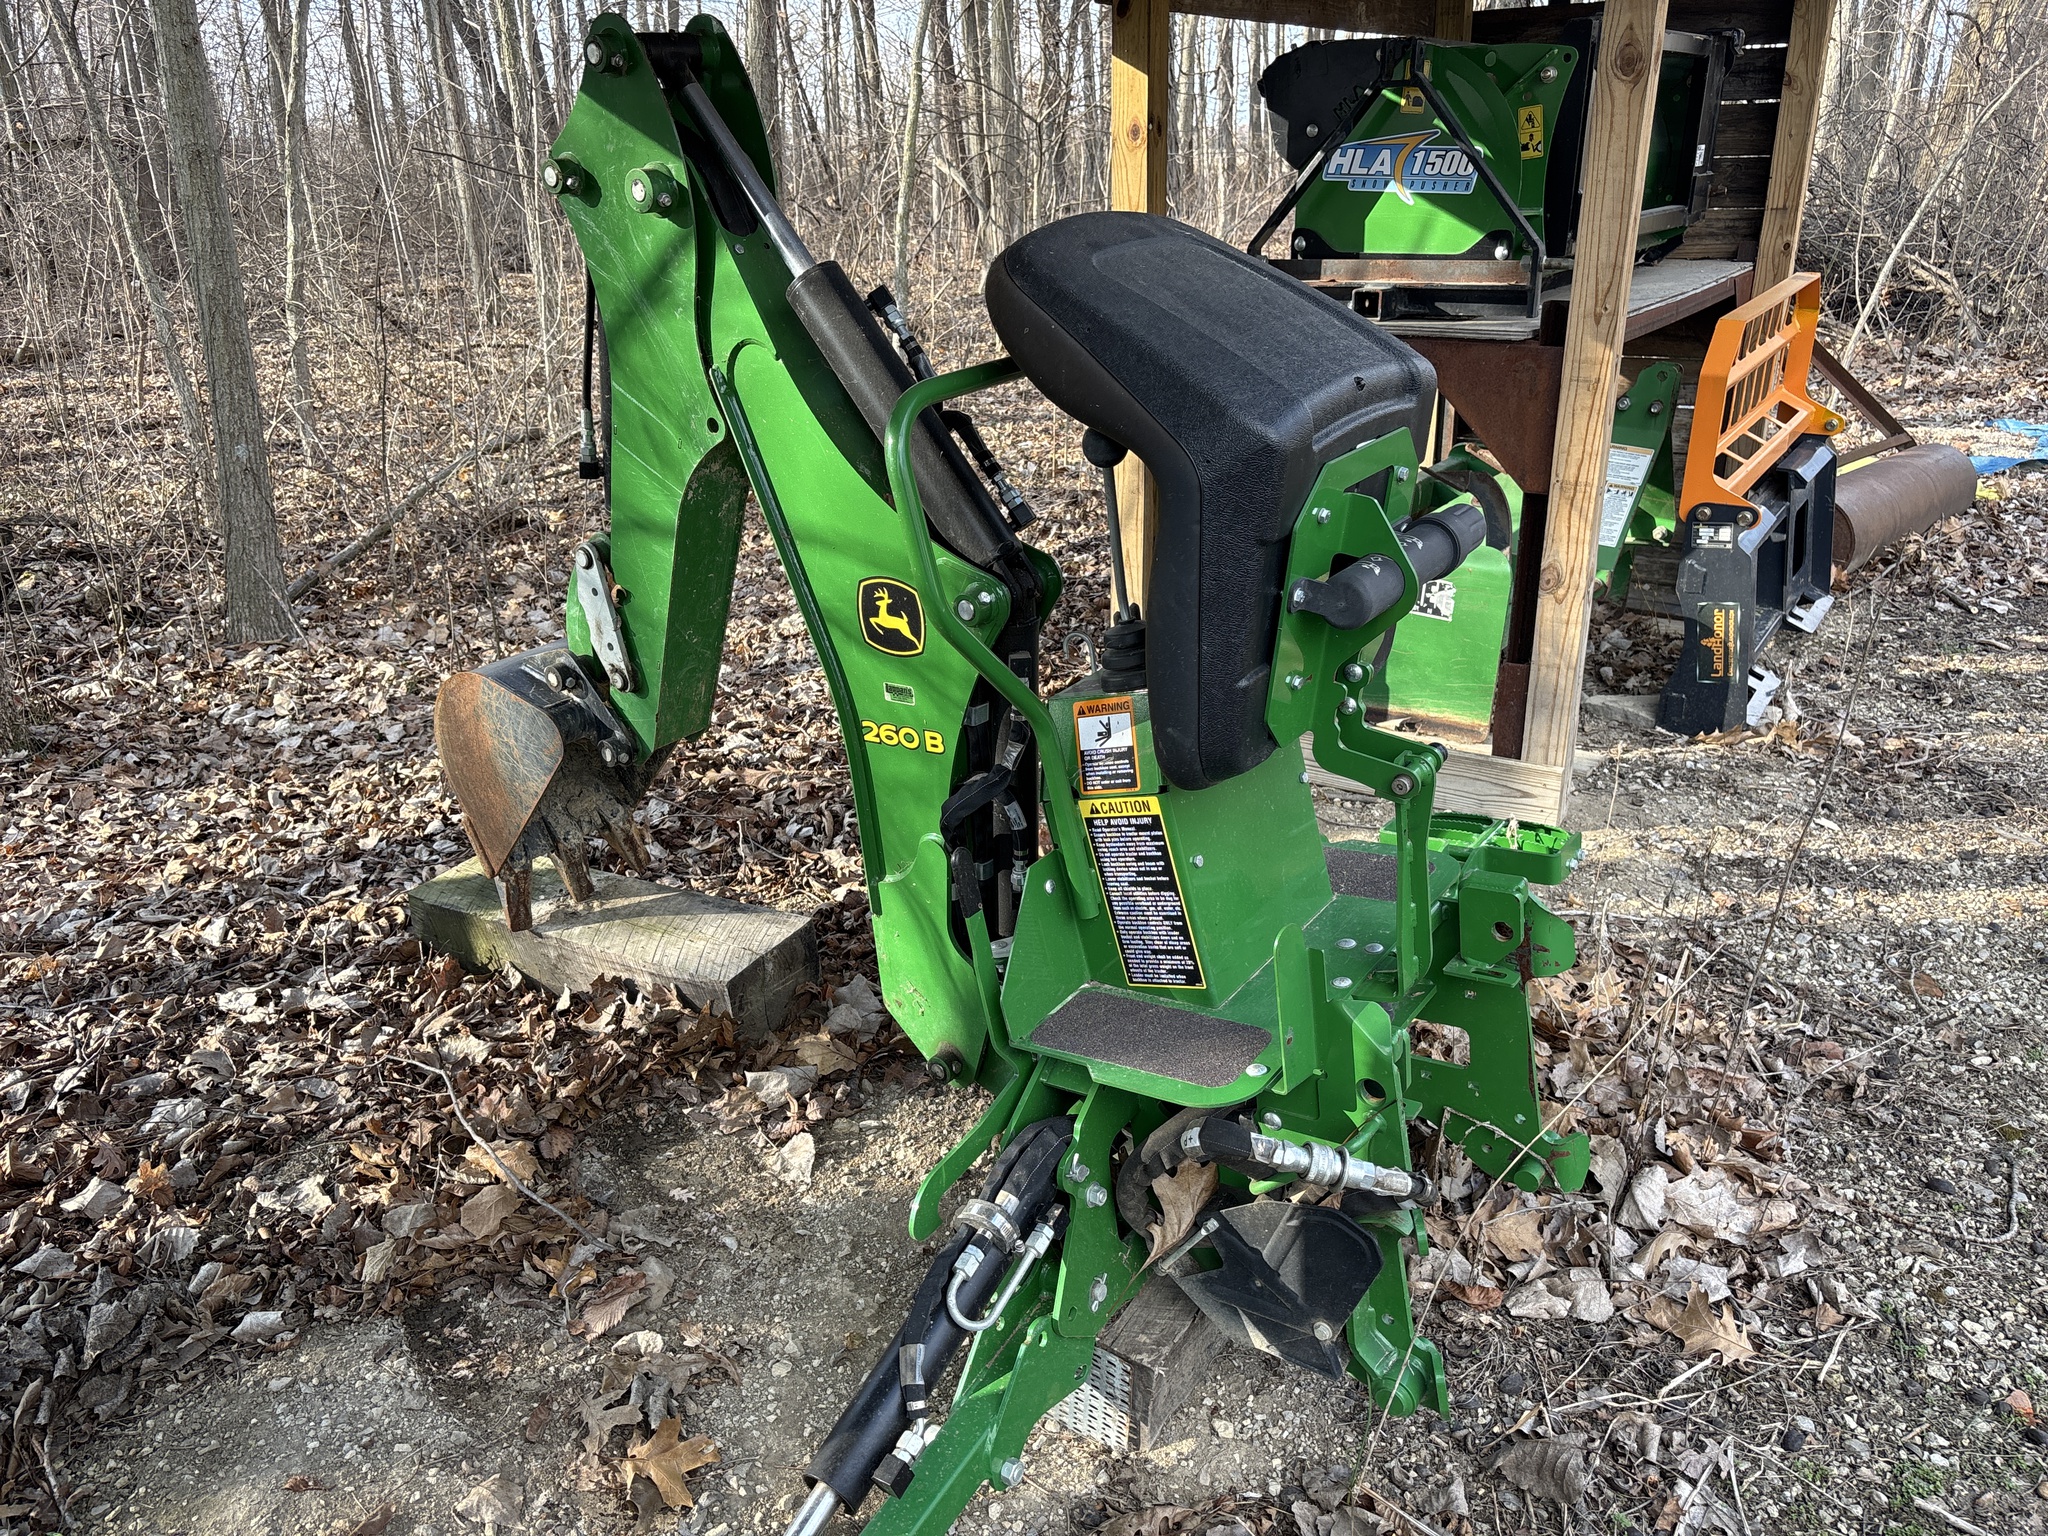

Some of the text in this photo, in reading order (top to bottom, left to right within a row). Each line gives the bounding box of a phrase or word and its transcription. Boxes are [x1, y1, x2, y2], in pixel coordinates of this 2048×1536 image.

[1328, 148, 1474, 177] HLA 1500
[1351, 179, 1471, 191] SNOW PUSHER
[1710, 608, 1724, 677] LandHonor
[1086, 701, 1130, 714] WARNING
[861, 720, 946, 755] 260 B
[1100, 800, 1151, 814] CAUTION
[1129, 817, 1152, 825] INJURY
